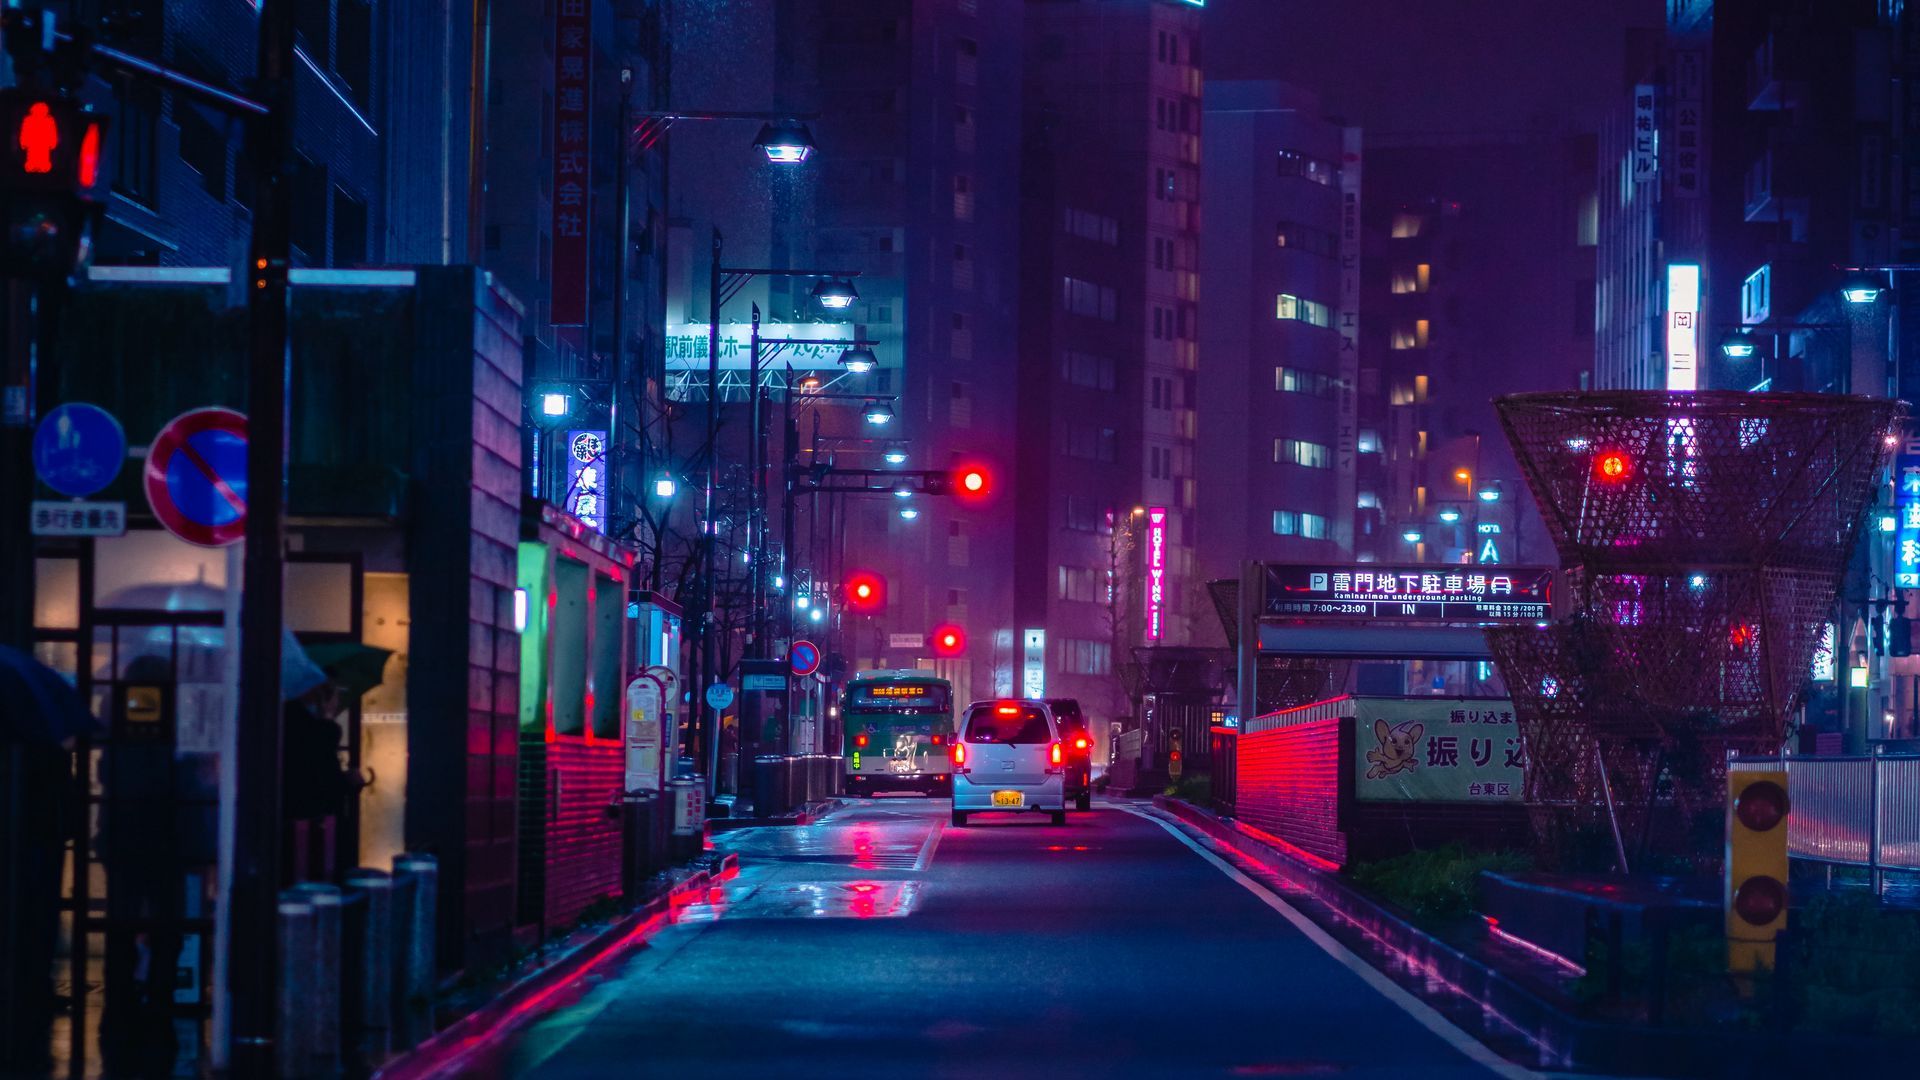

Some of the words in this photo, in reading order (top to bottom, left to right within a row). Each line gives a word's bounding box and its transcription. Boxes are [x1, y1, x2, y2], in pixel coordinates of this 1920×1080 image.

[1332, 572, 1487, 594] 雷門地下駐車場
[1334, 592, 1389, 600] Kaminarimon
[1392, 594, 1447, 602] underground
[1450, 594, 1482, 603] parking
[1402, 604, 1416, 615] IN
[1450, 710, 1514, 725] 振り込ま
[1469, 782, 1510, 796] 台東区
